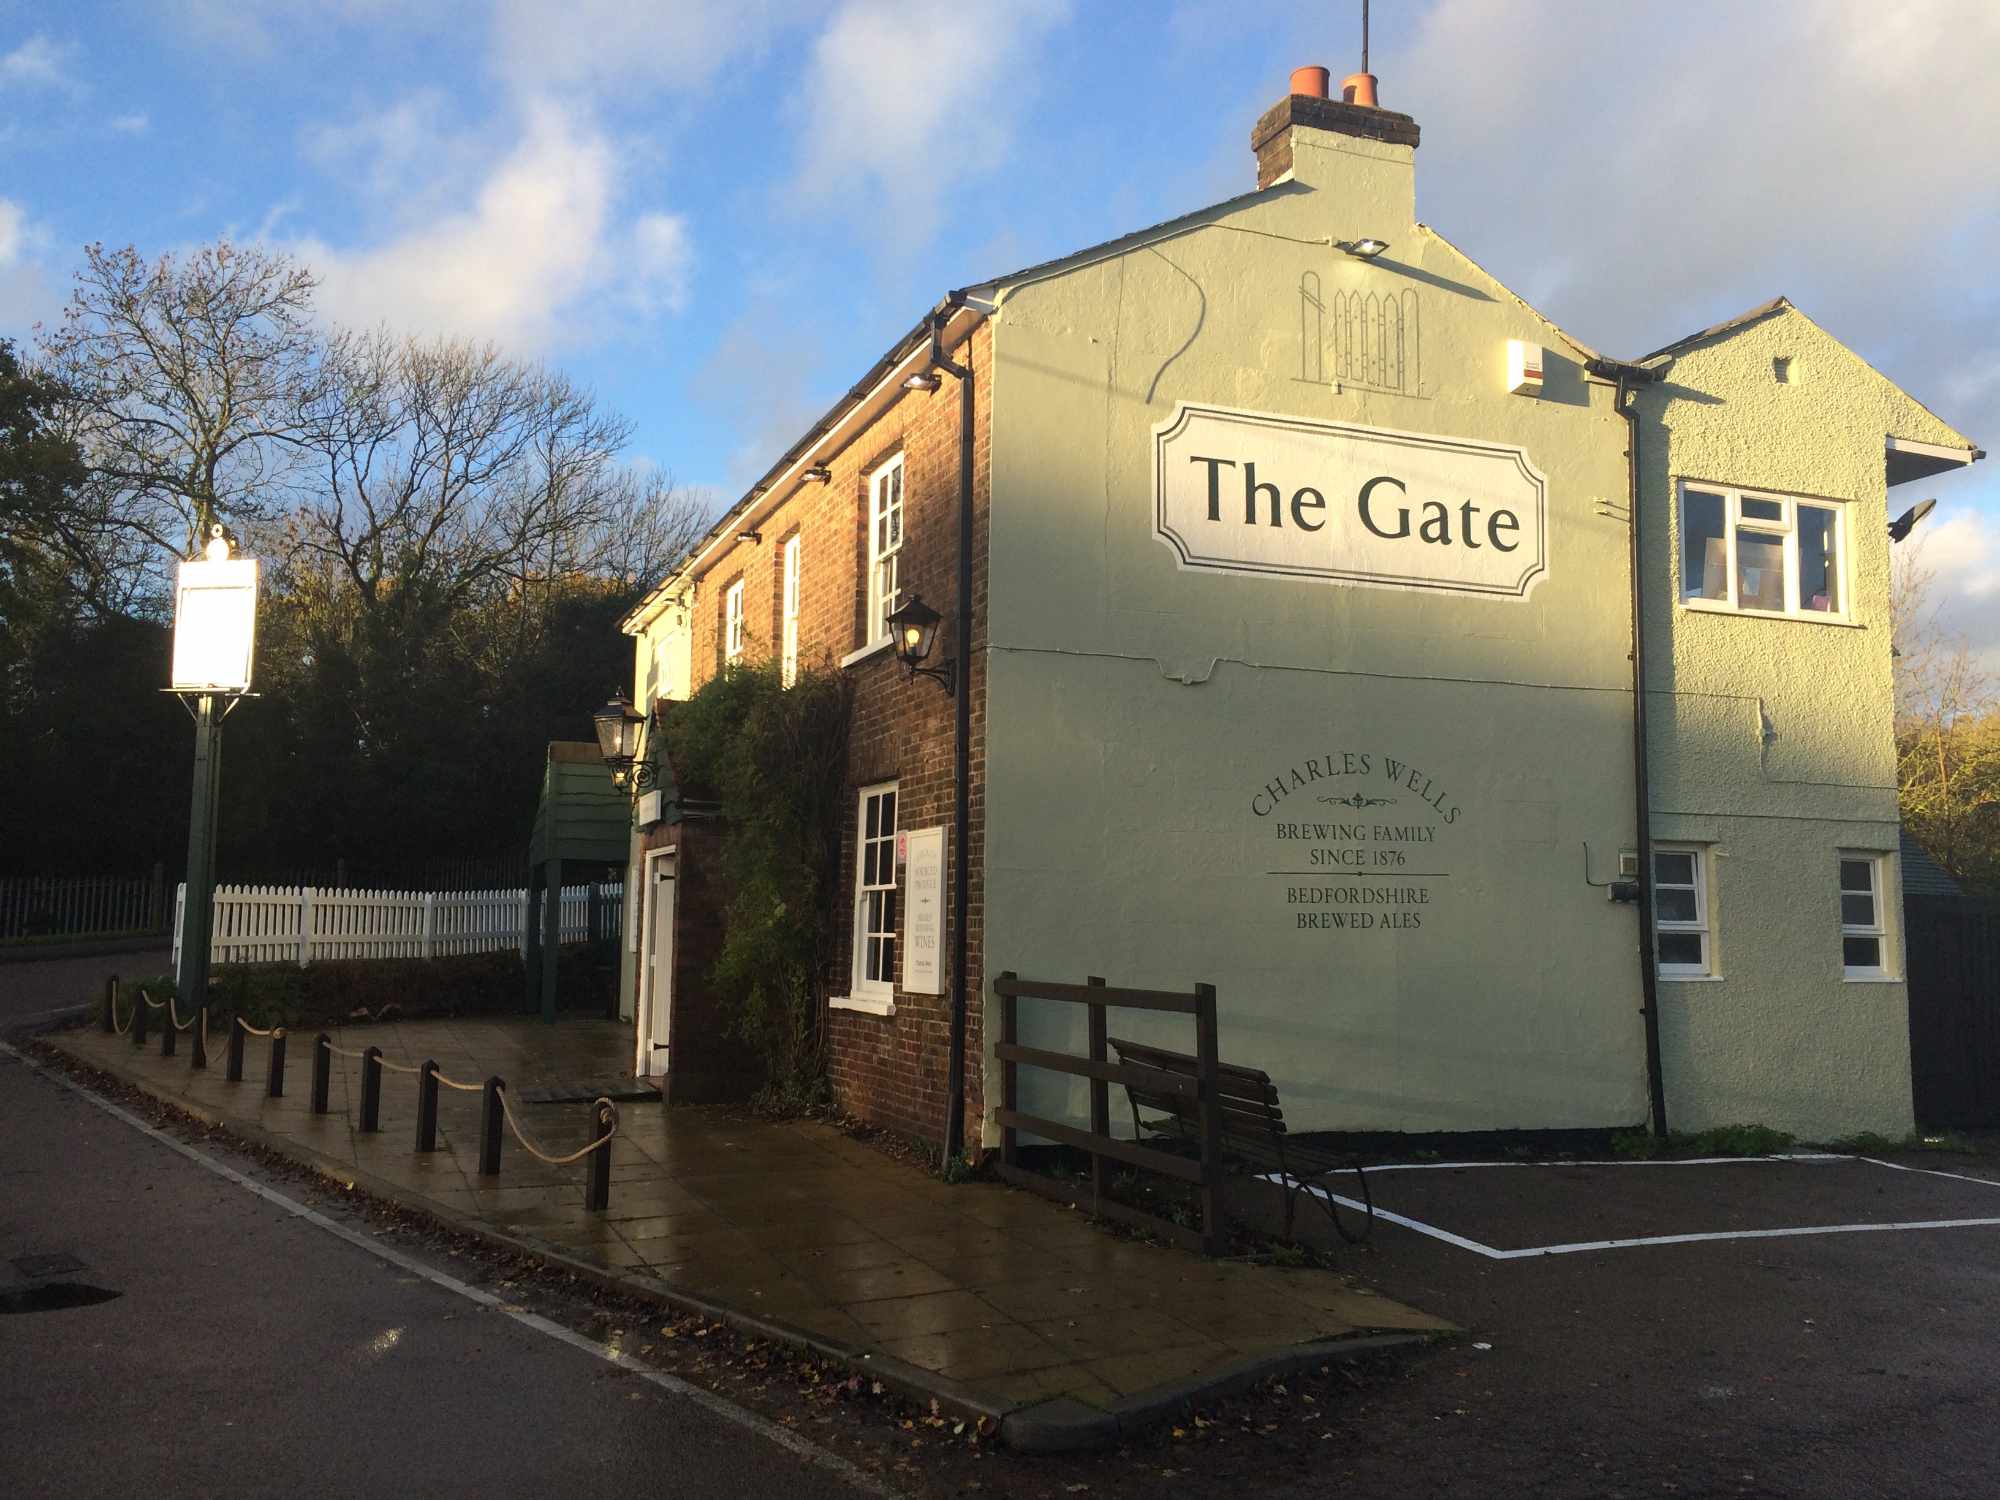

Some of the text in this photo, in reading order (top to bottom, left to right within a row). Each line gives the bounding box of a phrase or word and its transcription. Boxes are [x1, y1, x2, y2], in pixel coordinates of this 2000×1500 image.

[1190, 455, 1520, 552] The Gate
[1251, 753, 1461, 824] CHARLES WELLS
[1277, 823, 1436, 842] BREWING FAMILY
[1310, 849, 1405, 866] SINCE 1876
[1287, 887, 1429, 904] BEDFORDSHIRE
[1297, 912, 1421, 929] BREWED ALES
[914, 935, 935, 950] WINES
